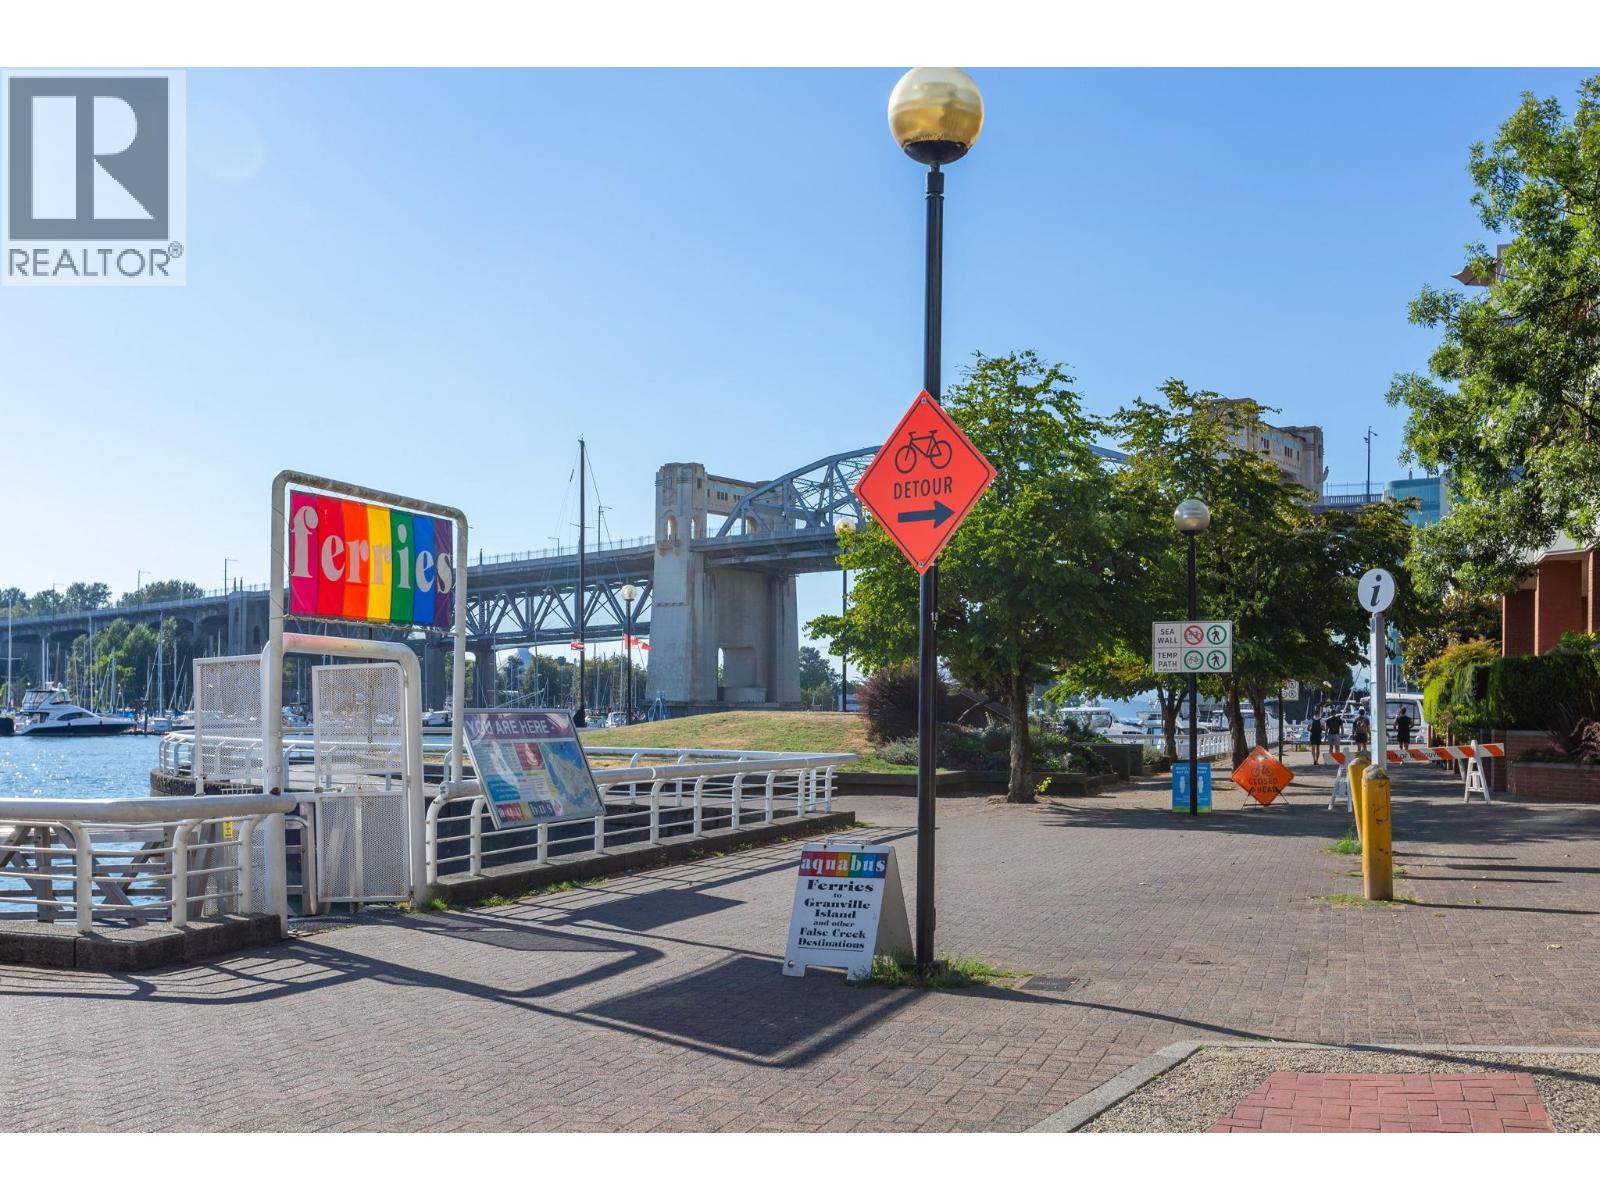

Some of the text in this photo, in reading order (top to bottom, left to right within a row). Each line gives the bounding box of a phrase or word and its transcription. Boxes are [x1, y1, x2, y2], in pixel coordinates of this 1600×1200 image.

[893, 476, 953, 500] DETOUR
[290, 505, 453, 594] ferries
[465, 719, 550, 737] YOU ARE HERE
[800, 854, 886, 875] aquabus
[807, 879, 874, 892] Ferries
[804, 898, 871, 909] Granville
[814, 909, 857, 919] Island
[812, 919, 829, 927] and
[799, 927, 866, 939] False Creek
[797, 937, 865, 949] Destinations
